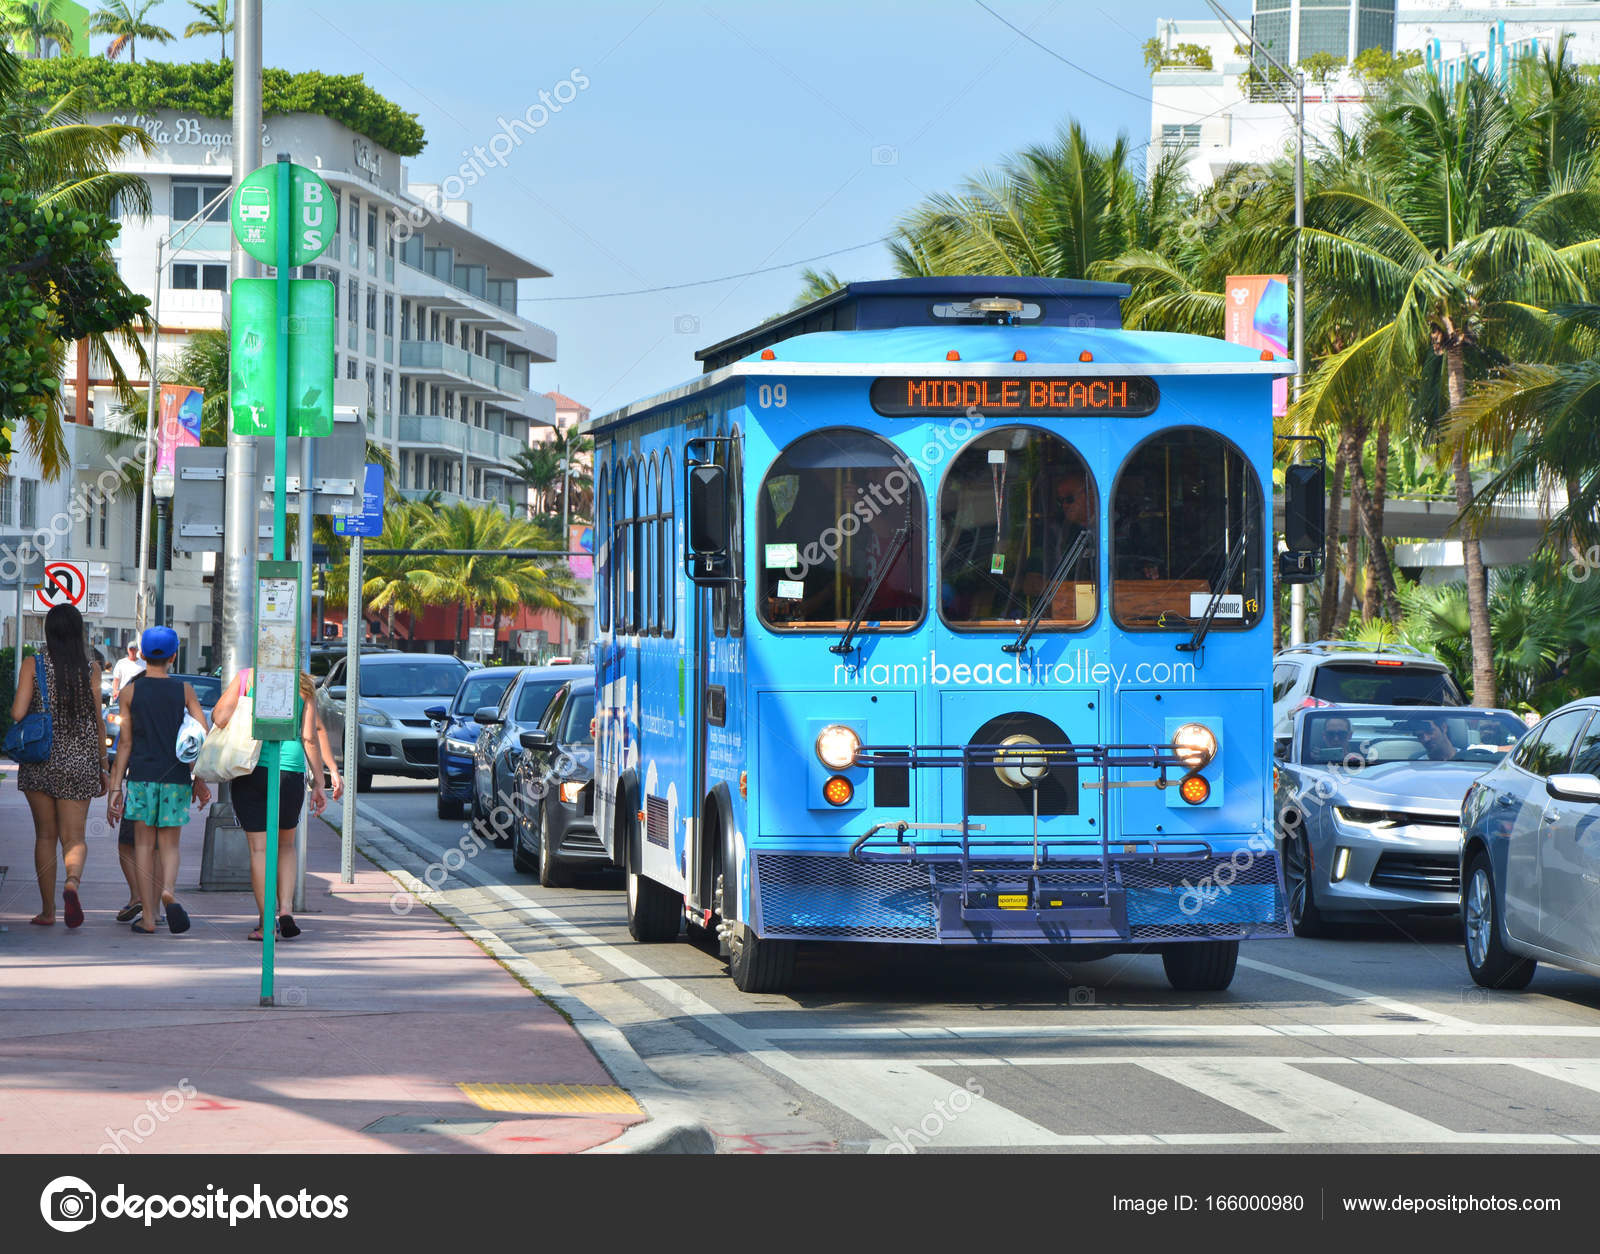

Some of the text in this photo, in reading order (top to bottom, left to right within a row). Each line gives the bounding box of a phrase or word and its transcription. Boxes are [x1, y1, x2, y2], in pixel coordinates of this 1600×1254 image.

[174, 118, 272, 153] Bagae
[303, 182, 323, 251] BUS
[758, 383, 788, 409] 09
[907, 380, 1128, 408] MIDDLE BEACH
[833, 648, 1196, 695] miamibeachtrolley.com
